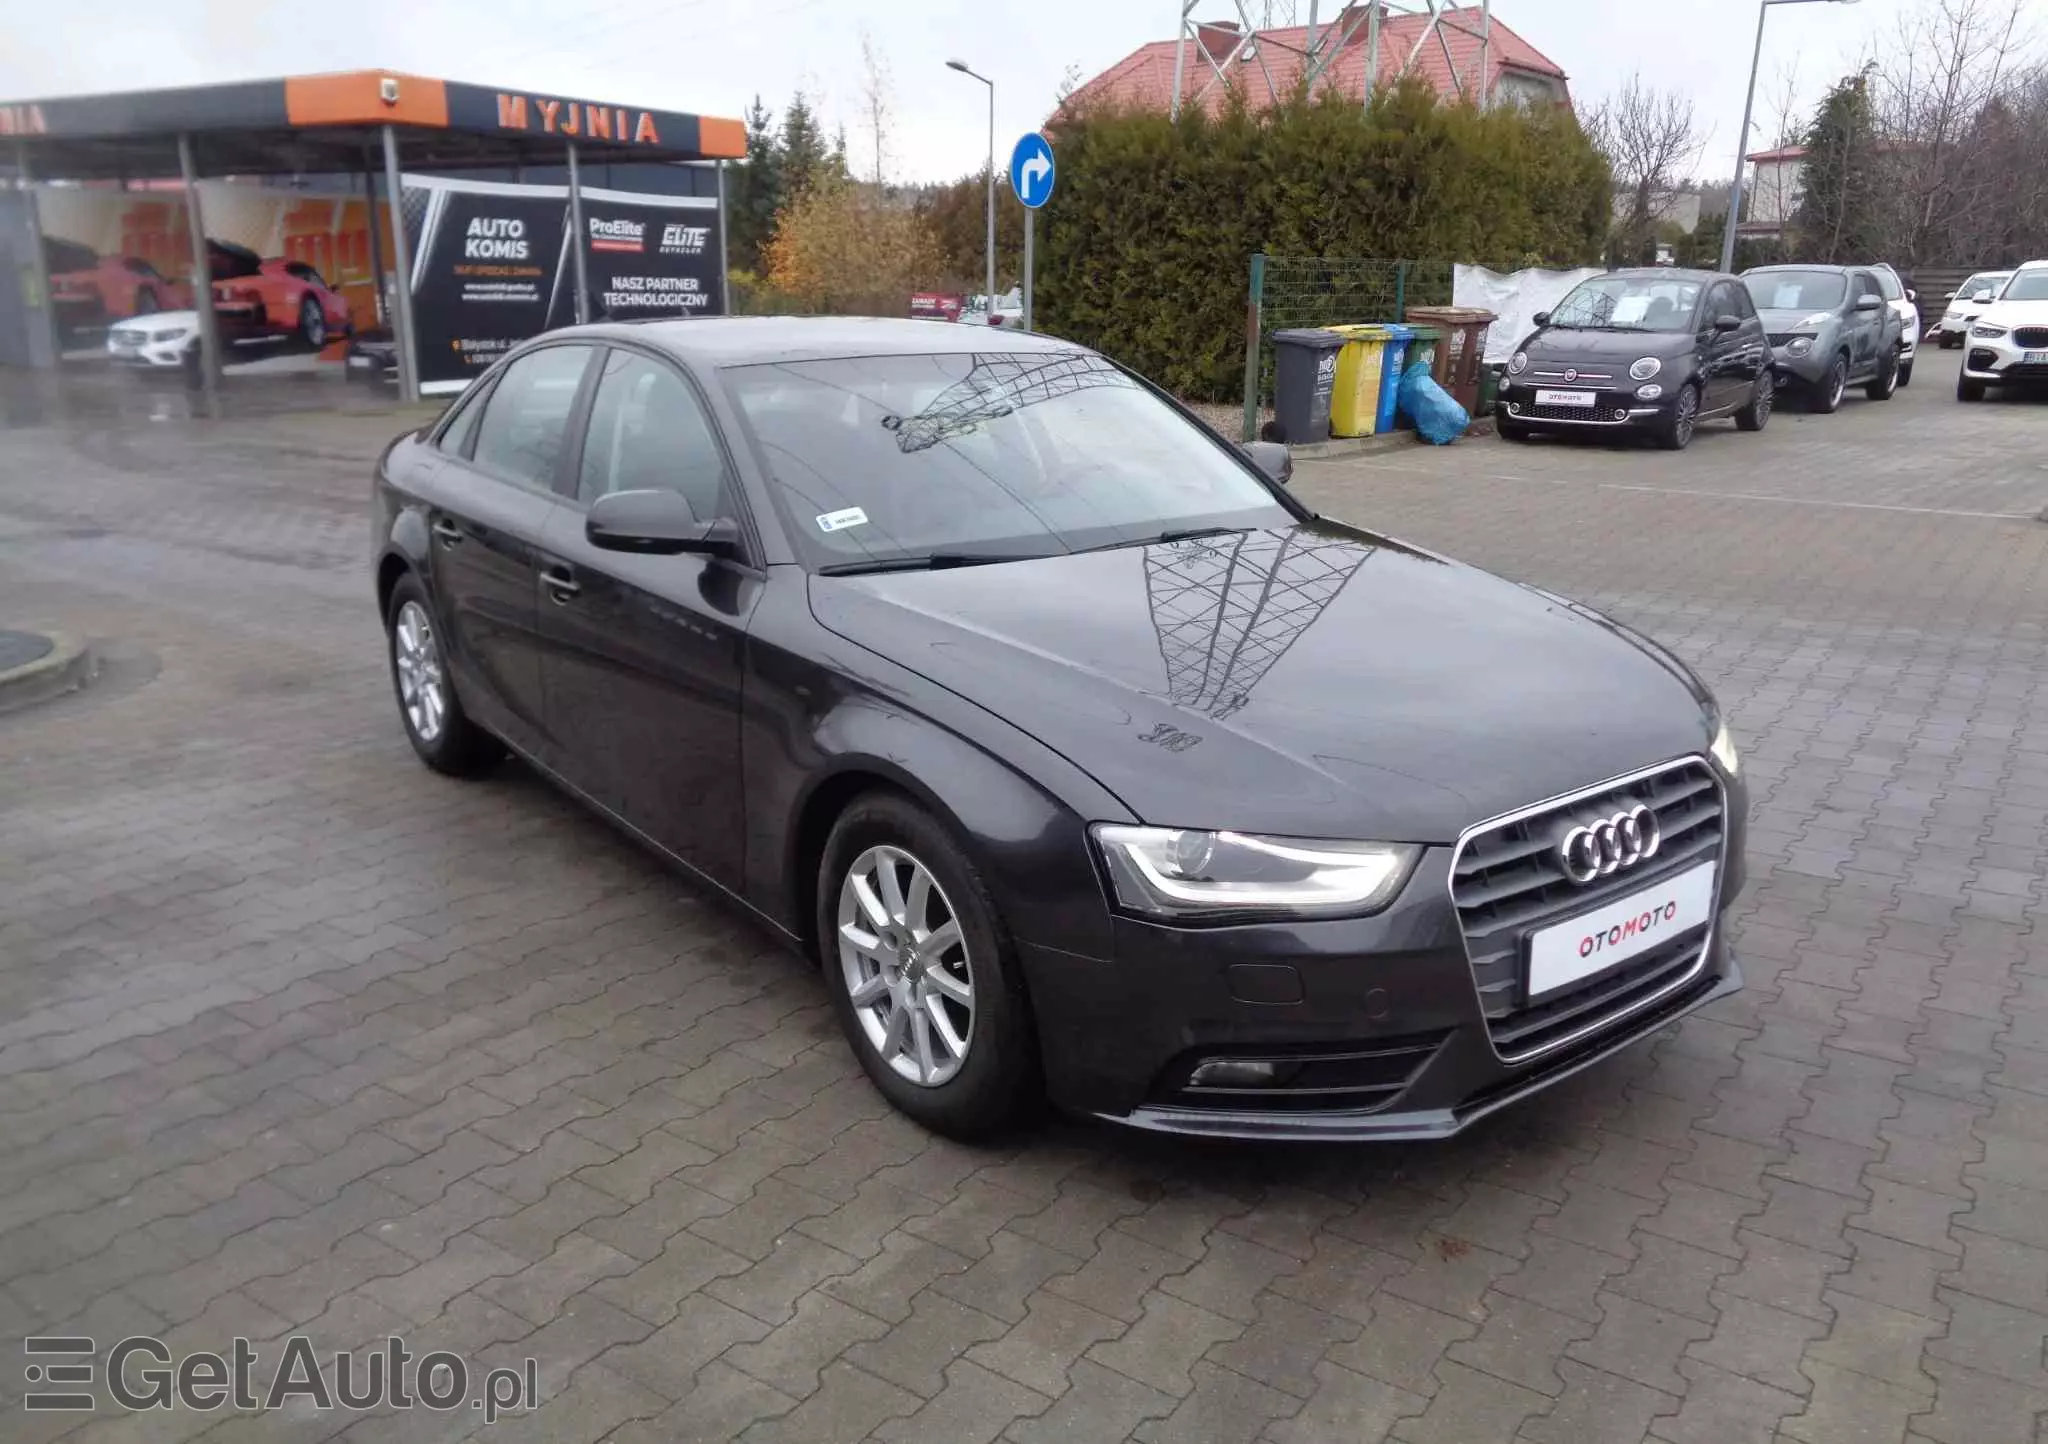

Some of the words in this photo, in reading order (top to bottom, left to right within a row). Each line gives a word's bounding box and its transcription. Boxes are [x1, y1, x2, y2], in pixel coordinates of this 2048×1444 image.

[497, 94, 658, 143] MYJNIA
[467, 217, 524, 238] AUTO
[589, 217, 643, 235] ProElite
[465, 239, 529, 259] KOMIS
[611, 276, 645, 290] NASZ
[646, 277, 699, 291] PARTNER
[603, 292, 708, 306] TECHNOLOGICZNY
[1579, 901, 1677, 958] OTOMOTO
